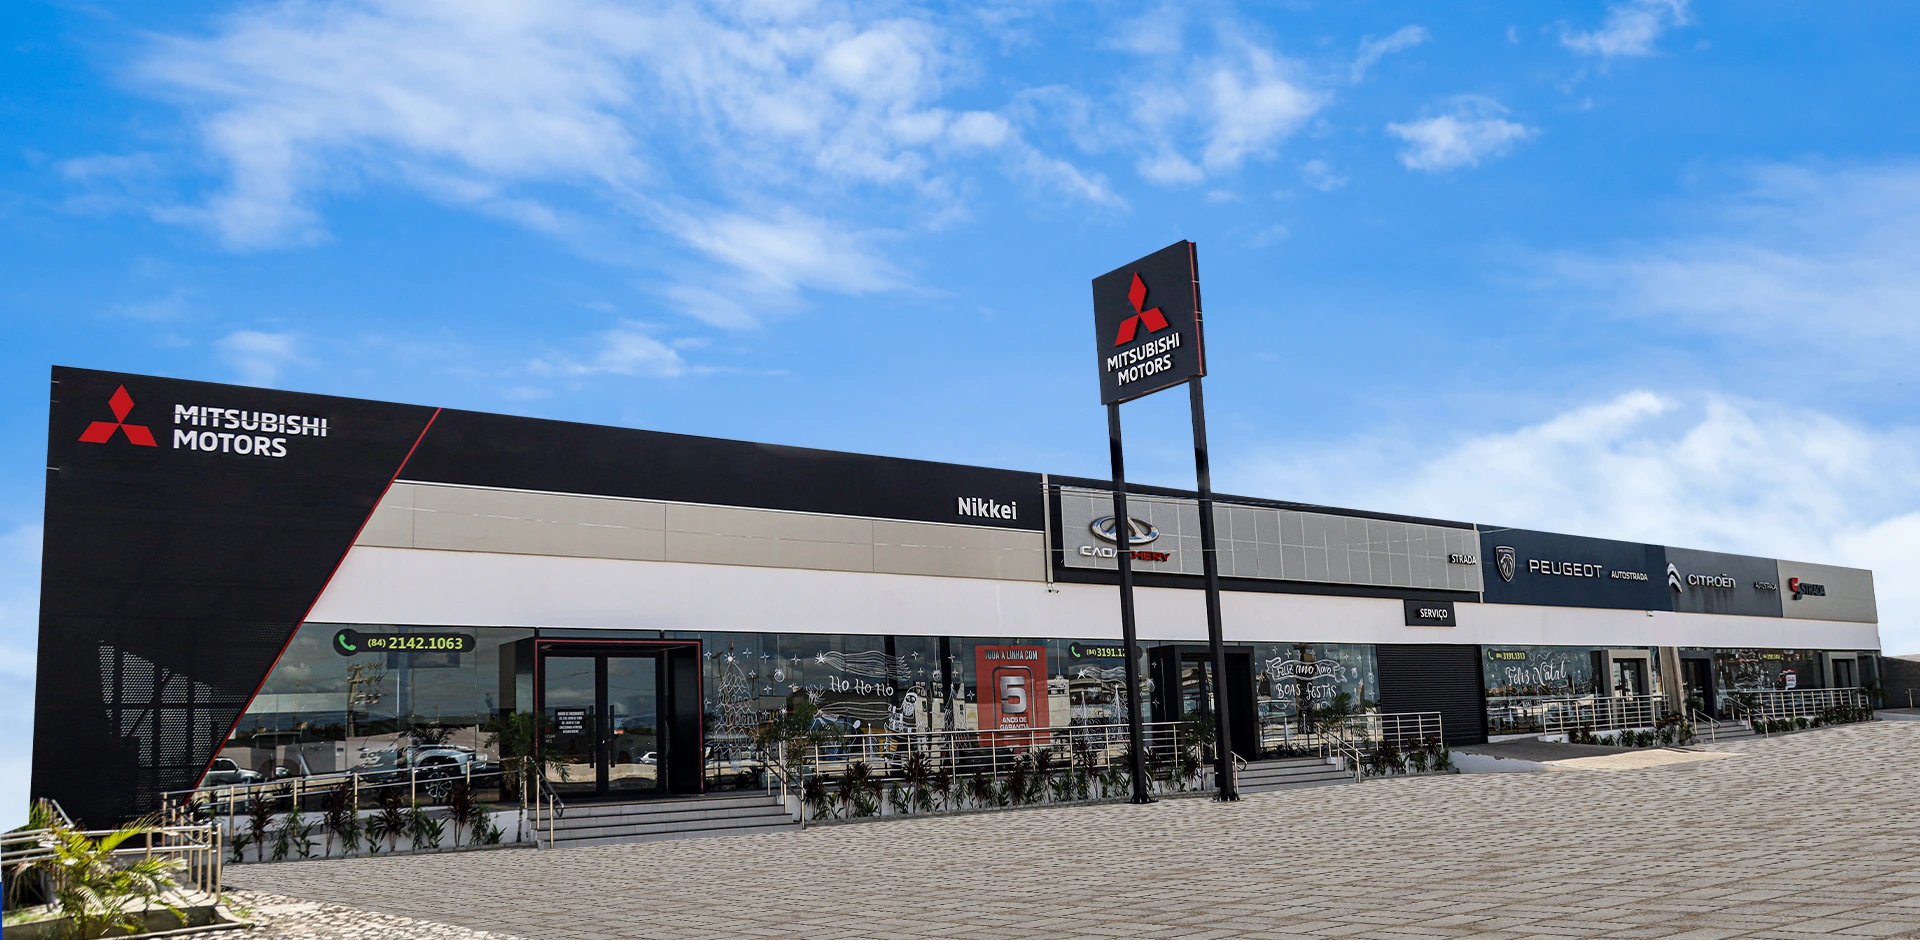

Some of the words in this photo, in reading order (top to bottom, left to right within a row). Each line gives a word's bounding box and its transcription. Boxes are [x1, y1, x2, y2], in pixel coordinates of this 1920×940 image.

[1107, 332, 1180, 373] MITSUBISHI
[1118, 354, 1172, 386] MOTORS
[174, 404, 328, 437] MITSUBISHI
[173, 429, 288, 458] MOTORS
[958, 497, 1017, 520] Nikkei
[1451, 554, 1477, 565] STRADA
[1528, 559, 1602, 578] PEUGEOT
[1611, 570, 1648, 581] AUTOSTRADA
[1687, 573, 1736, 589] CITROËN
[1420, 608, 1448, 621] SERVIÇO
[367, 638, 387, 648] (84)
[388, 637, 463, 650] 2142.1063
[1001, 650, 1006, 660] A
[1006, 650, 1024, 660] LINHA
[1025, 650, 1038, 660] COM
[1505, 666, 1530, 686] Feliz
[1532, 660, 1567, 686] Natal
[1000, 676, 1027, 714] 5
